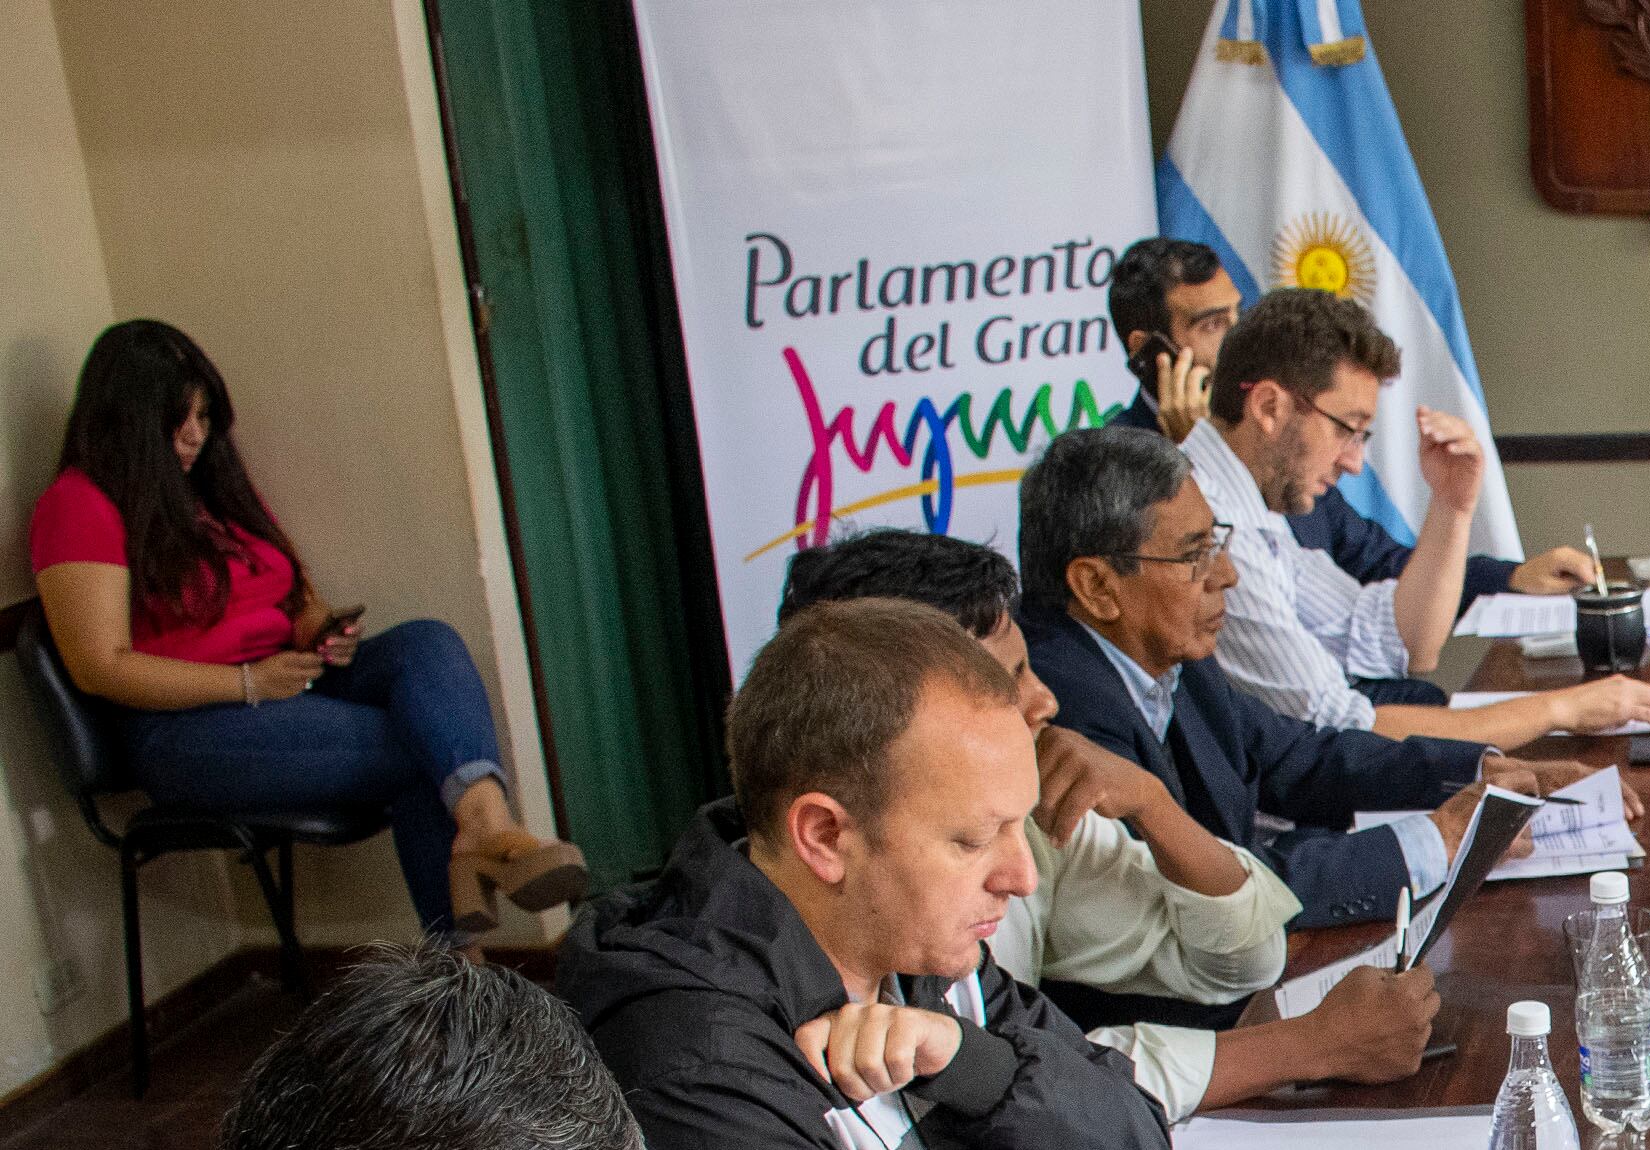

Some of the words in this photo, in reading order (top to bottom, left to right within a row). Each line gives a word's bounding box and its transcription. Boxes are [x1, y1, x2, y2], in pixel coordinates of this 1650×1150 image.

[746, 232, 1118, 328] Parlamento
[860, 316, 954, 376] del
[976, 316, 1108, 366] Gran
